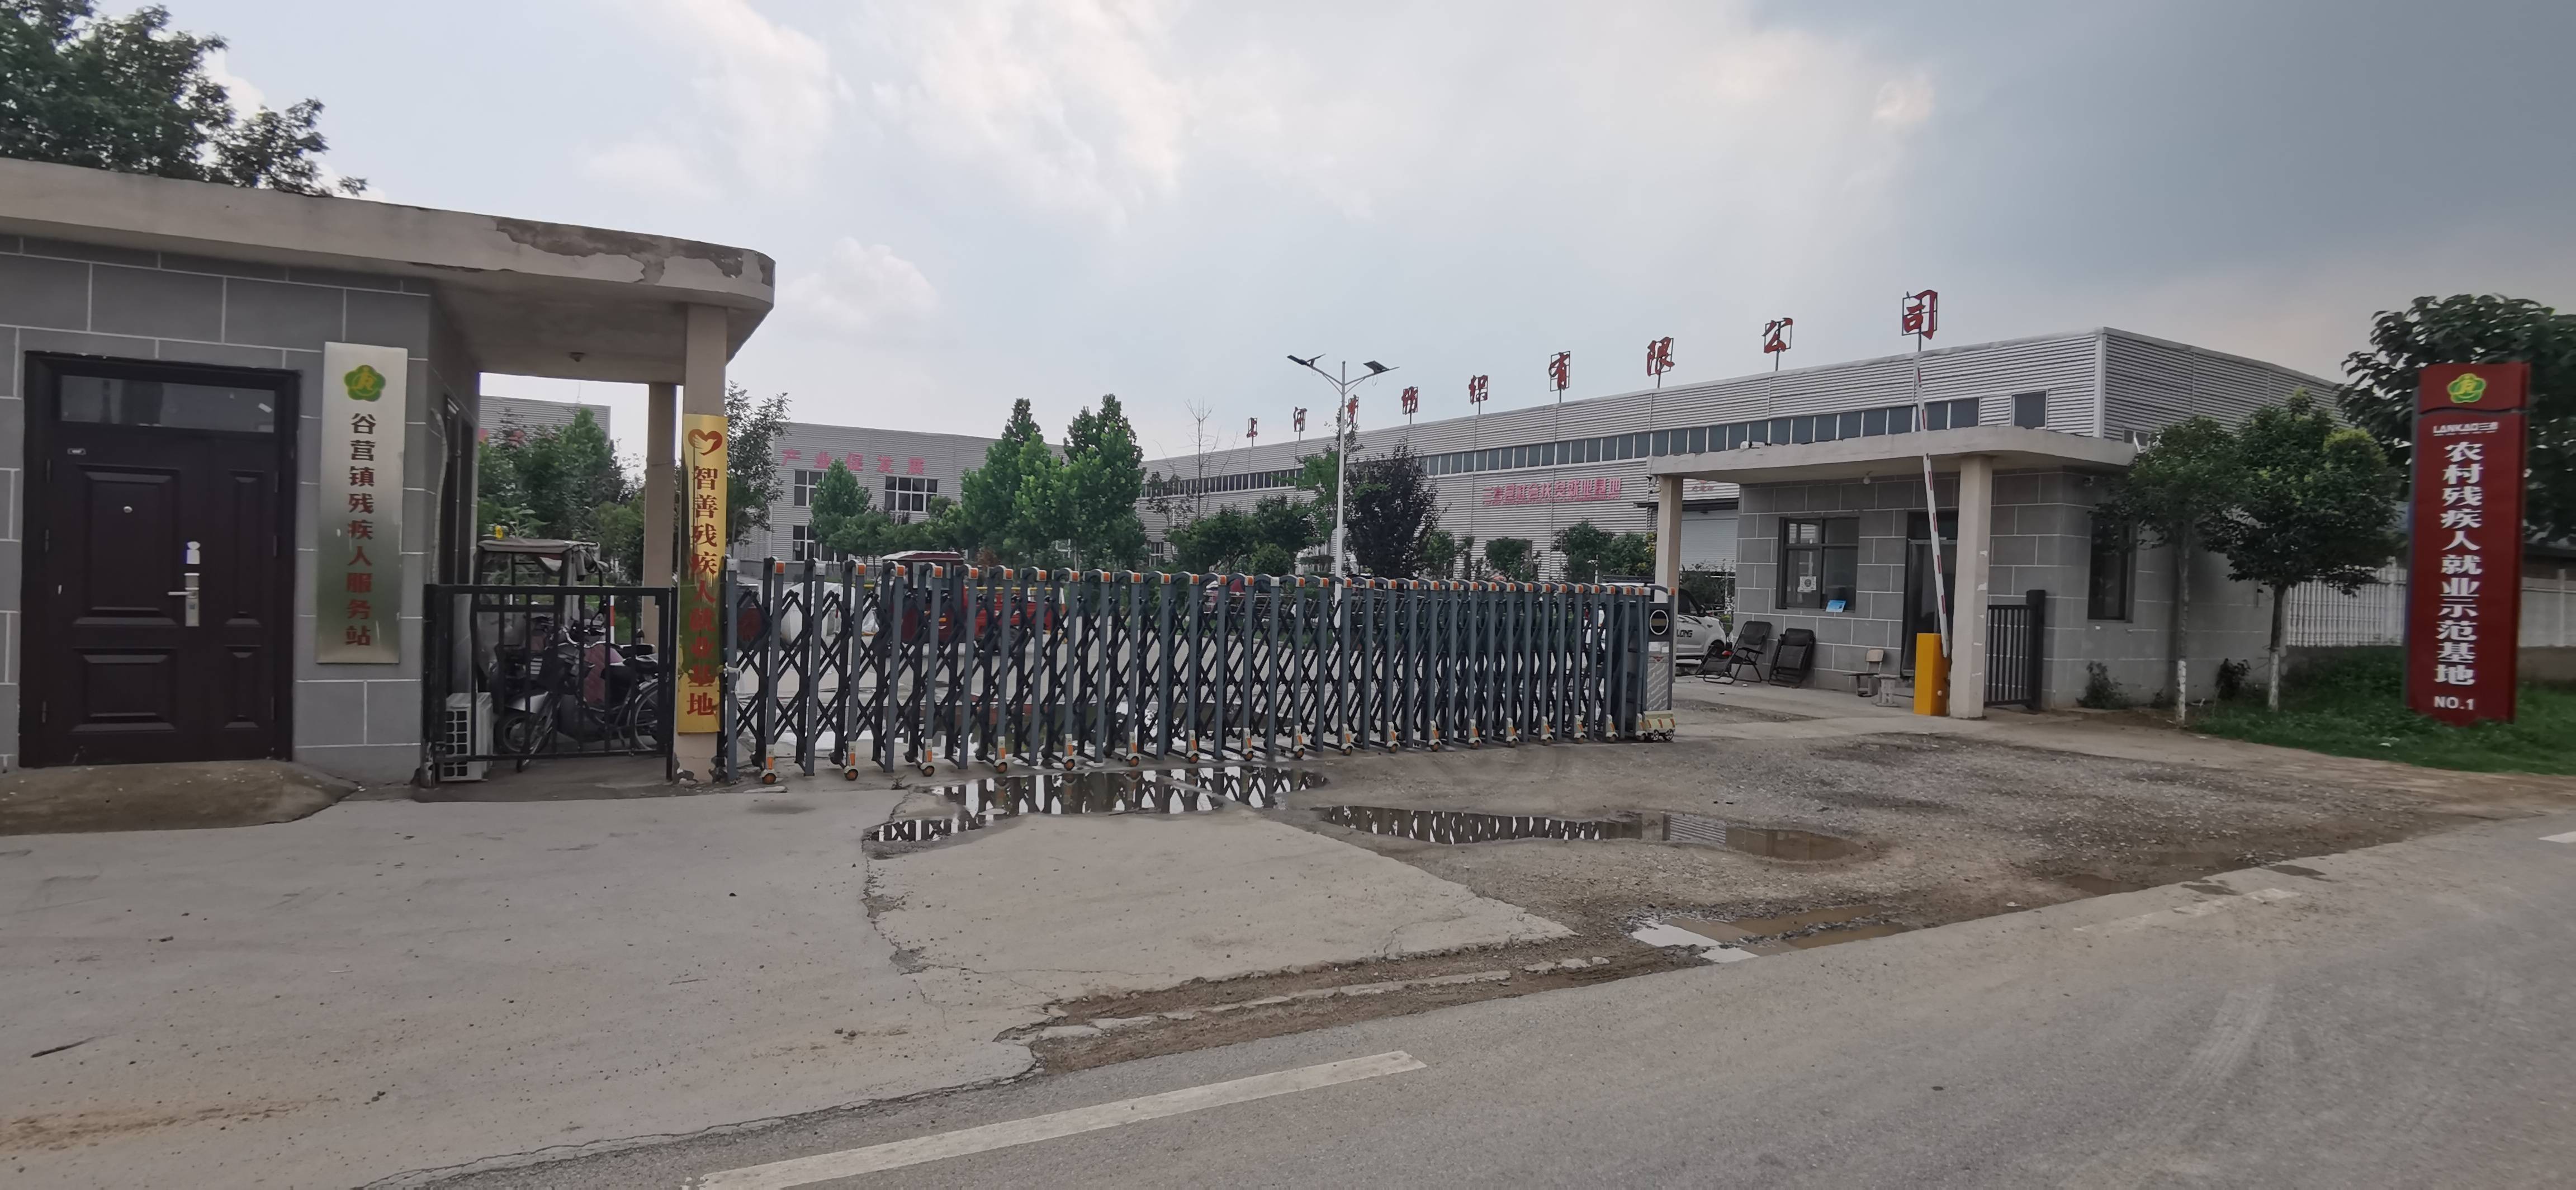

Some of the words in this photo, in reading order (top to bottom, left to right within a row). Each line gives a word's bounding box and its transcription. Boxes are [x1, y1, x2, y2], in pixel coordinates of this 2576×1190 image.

[345, 413, 376, 647] 谷营镇残疾人服务站
[686, 465, 719, 716] 智善残疾人就业基地
[2433, 441, 2484, 686] 农村残疾人就业示范基地
[2434, 696, 2474, 711] NO.1
